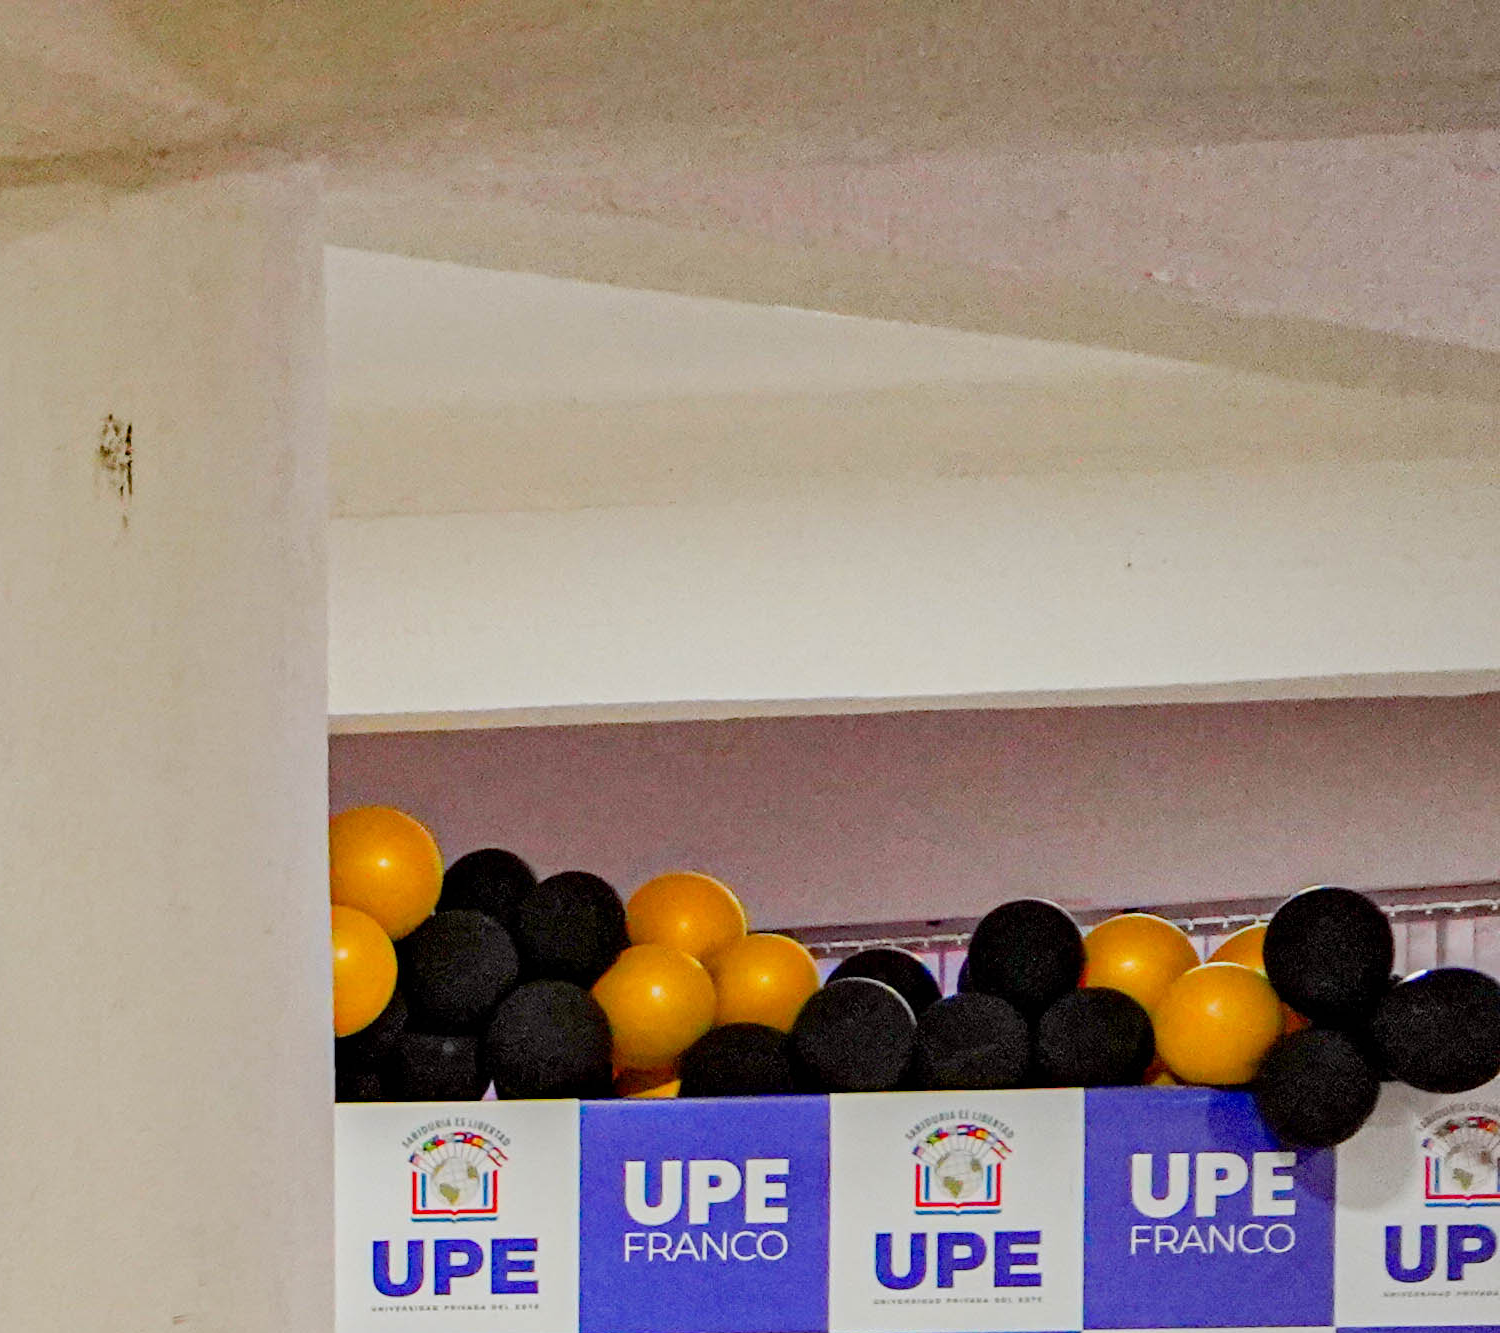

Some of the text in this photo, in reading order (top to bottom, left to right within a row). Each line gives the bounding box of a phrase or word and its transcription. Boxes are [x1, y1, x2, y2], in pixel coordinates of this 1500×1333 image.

[624, 1158, 790, 1225] UPE
[1131, 1151, 1296, 1217] UPE
[372, 1238, 538, 1297] UPE
[624, 1231, 788, 1261] FRANCO
[874, 1230, 1041, 1290] UPE
[1130, 1224, 1296, 1254] FRANCO
[1385, 1223, 1496, 1283] UP
